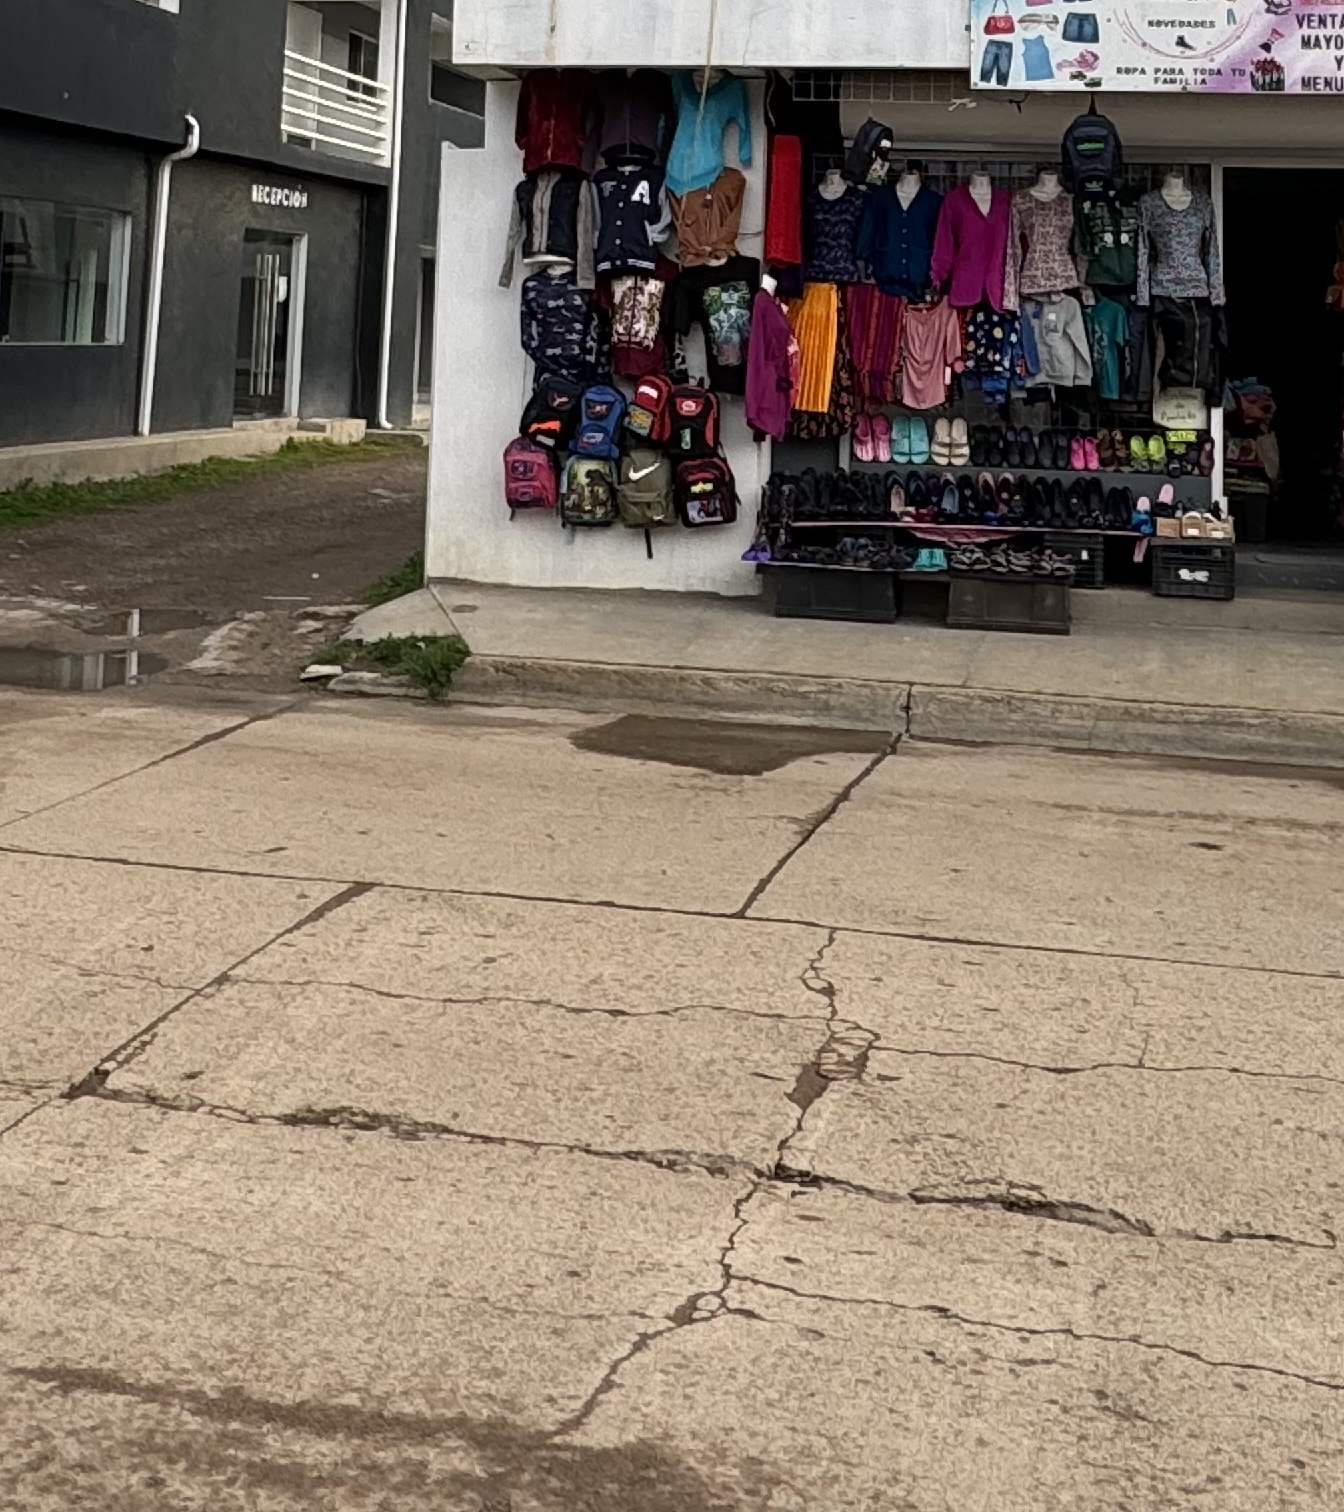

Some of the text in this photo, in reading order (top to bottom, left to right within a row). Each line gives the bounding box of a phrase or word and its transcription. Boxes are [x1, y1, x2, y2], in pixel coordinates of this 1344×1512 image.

[1147, 20, 1216, 28] NOVEDADES
[1116, 67, 1147, 76] ROPA
[1154, 67, 1185, 76] PARA
[1193, 68, 1224, 77] TODA
[1153, 77, 1208, 86] FAMILIA
